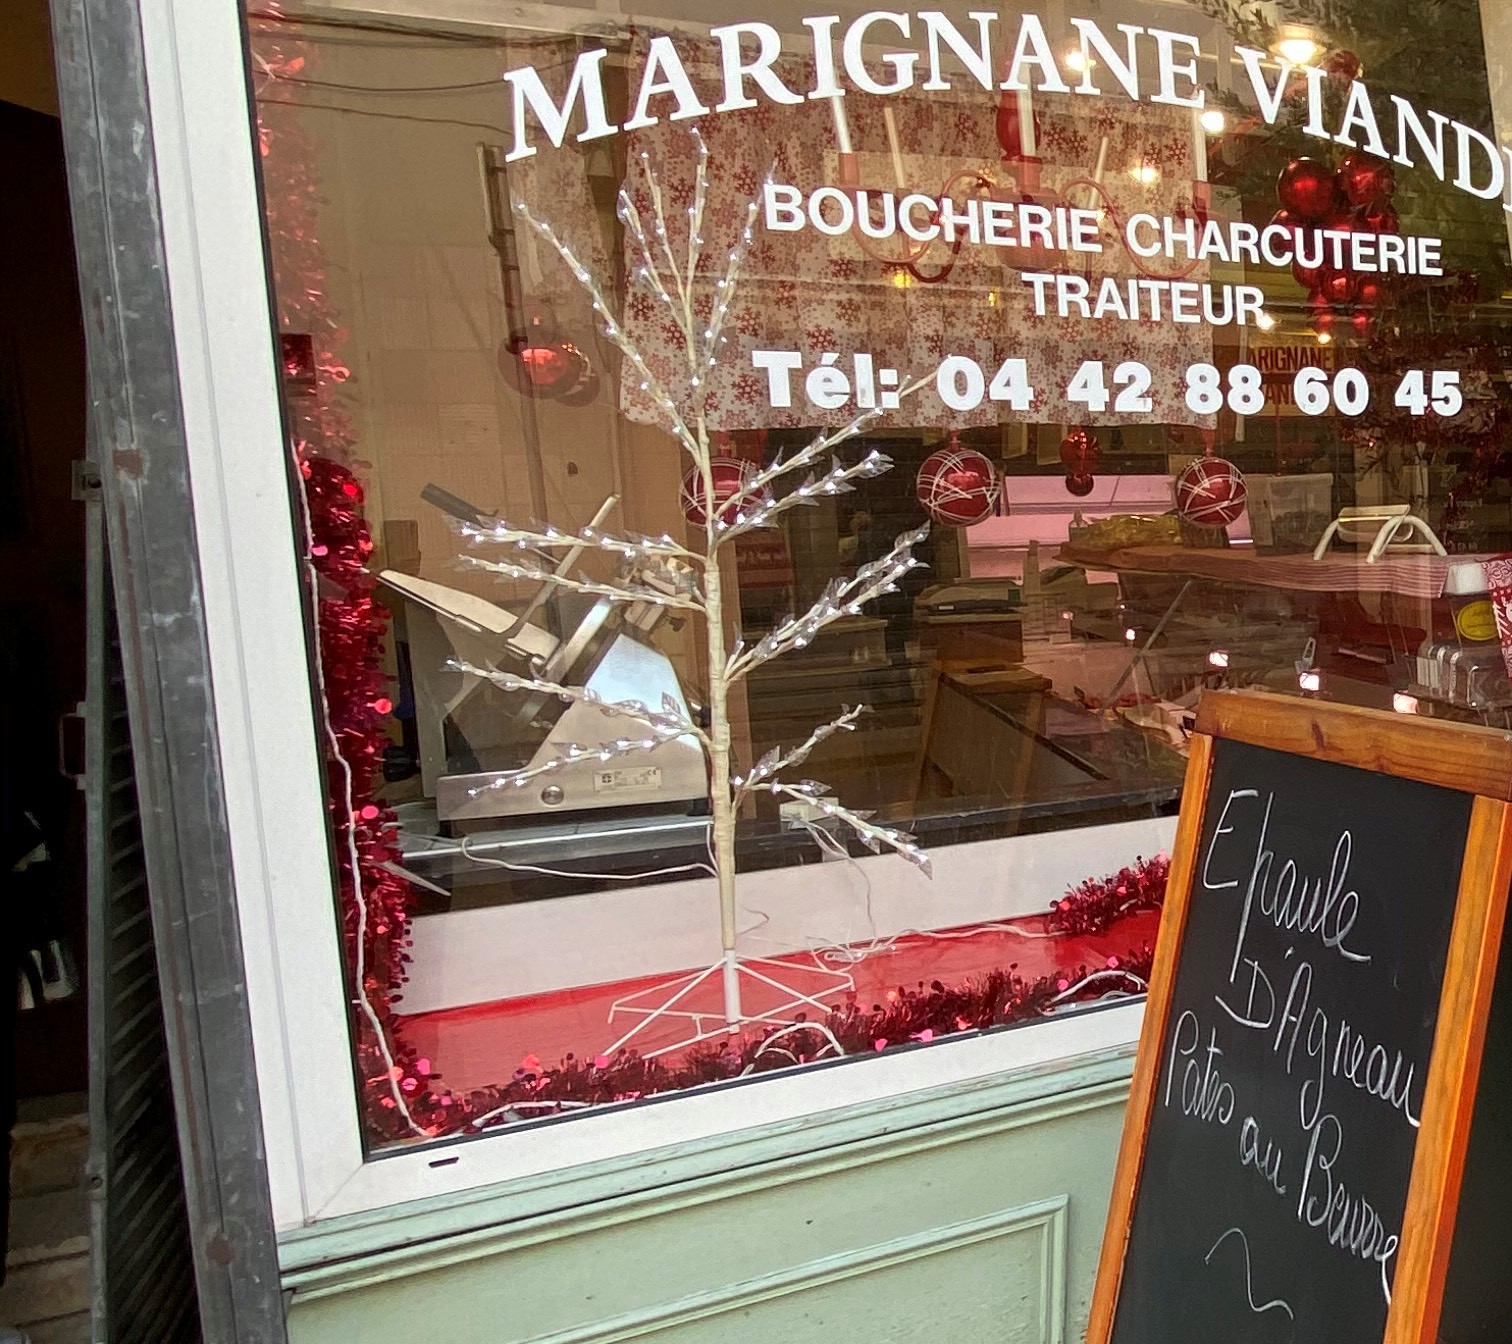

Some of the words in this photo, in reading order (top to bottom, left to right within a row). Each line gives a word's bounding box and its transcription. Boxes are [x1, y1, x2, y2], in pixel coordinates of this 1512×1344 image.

[505, 10, 1205, 161] MARIGNANE
[764, 183, 1103, 254] BOUCHERIE
[1126, 213, 1444, 277] CHARCUTERIE
[1021, 271, 1264, 326] TRAITEUR
[752, 349, 900, 415] Tél:
[934, 354, 1034, 414] 04
[1066, 357, 1154, 414] 42
[1183, 360, 1266, 416] 88
[1293, 366, 1371, 417] 60
[1393, 368, 1463, 418] 45
[1202, 789, 1372, 984] Epaule
[1239, 1116, 1287, 1195] au
